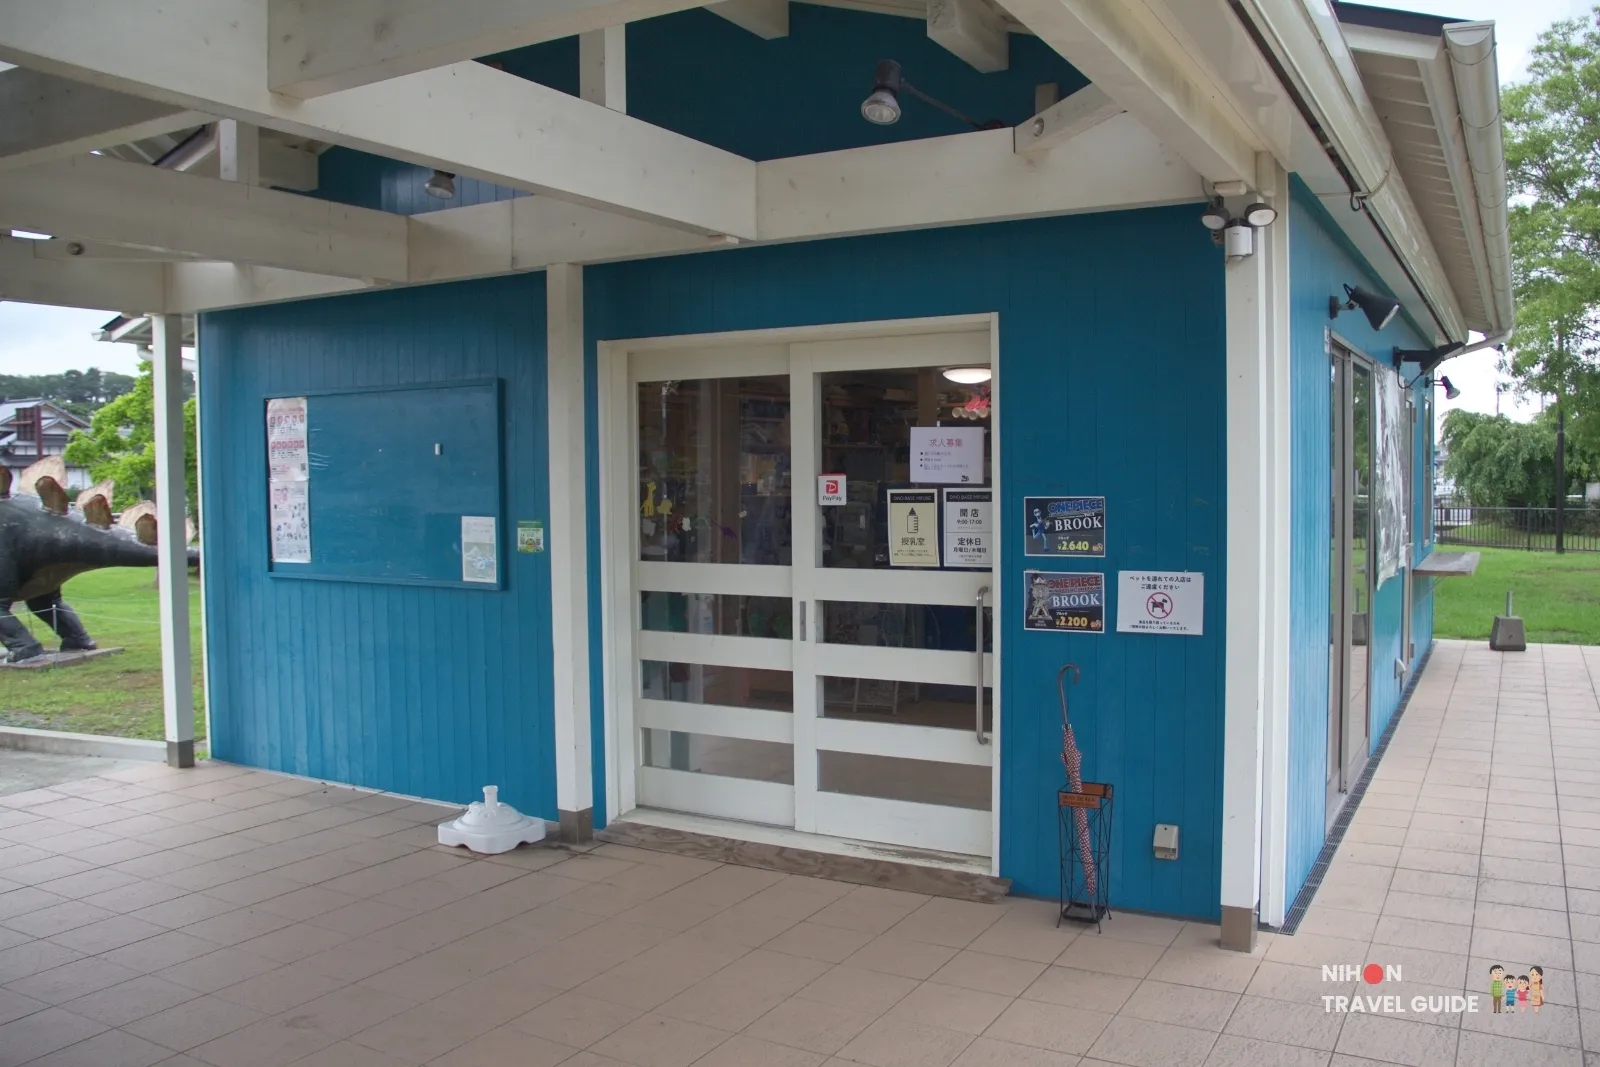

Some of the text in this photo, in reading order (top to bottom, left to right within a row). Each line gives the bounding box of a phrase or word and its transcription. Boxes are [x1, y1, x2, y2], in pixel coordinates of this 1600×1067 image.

[929, 438, 964, 448] 求人募集
[1047, 498, 1103, 513] ONE PIECE
[959, 508, 979, 518] 開店
[1054, 516, 1103, 531] BROOK
[901, 537, 926, 546] 授乳室
[957, 537, 981, 546] 定休日
[1069, 575, 1101, 587] PIECE
[1140, 583, 1180, 591] ご遠慮ください
[1052, 593, 1100, 607] BROOK
